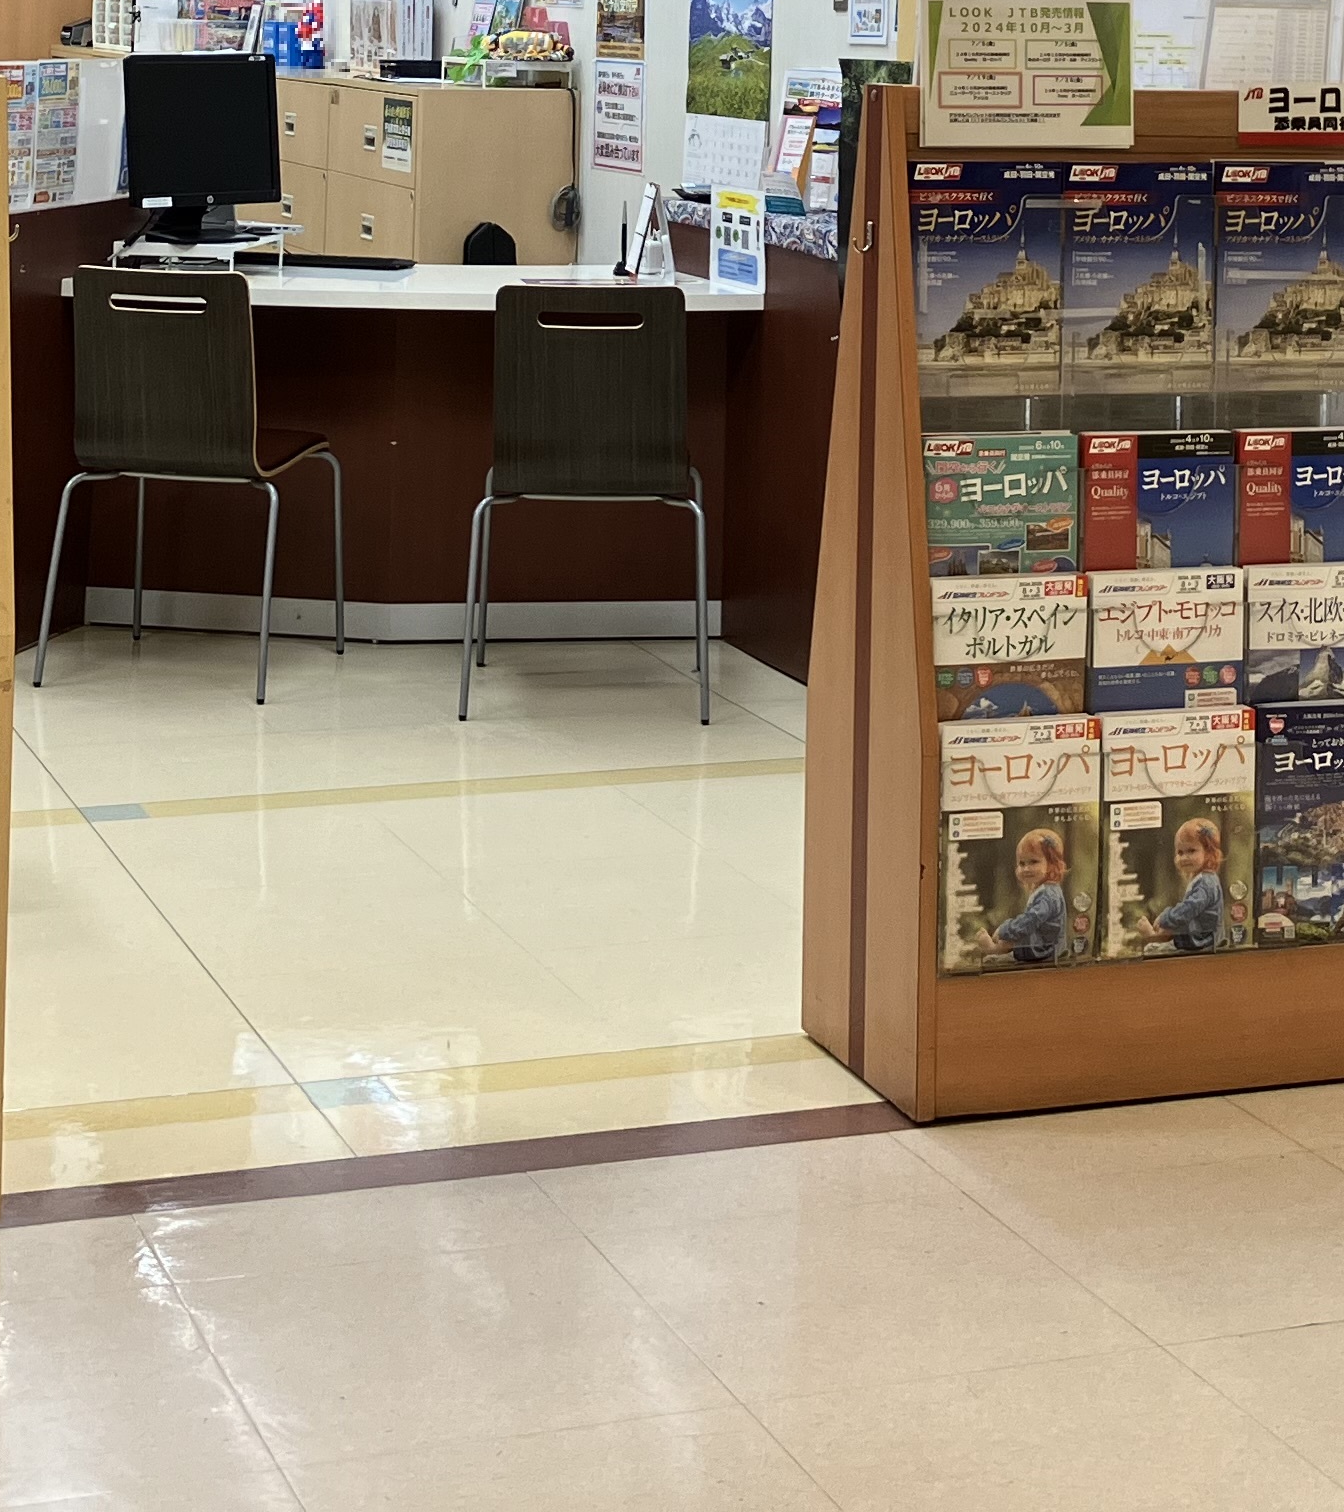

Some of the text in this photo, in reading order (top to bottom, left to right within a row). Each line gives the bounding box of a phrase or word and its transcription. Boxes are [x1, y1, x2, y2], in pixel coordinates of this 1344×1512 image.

[949, 7, 1084, 18] LOOK JTB発売情報
[1244, 87, 1263, 101] JTB
[917, 204, 1017, 233] ヨーロッパ
[1072, 205, 1171, 233] ヨーロッパ
[1224, 208, 1320, 234] ヨーロッパ
[927, 443, 957, 456] LOOK
[960, 466, 1068, 502] ヨーロッパ
[1141, 466, 1227, 491] ヨーロッパ
[1246, 481, 1282, 496] Quality
[1090, 485, 1129, 500] Quality
[942, 603, 1077, 634] イタリア・スペイン
[1098, 600, 1236, 622] エジプト・モロッコ
[965, 637, 1055, 658] ポルトガル
[949, 745, 1092, 787] ヨーロッパ
[1110, 736, 1246, 778] ヨーロッパ
